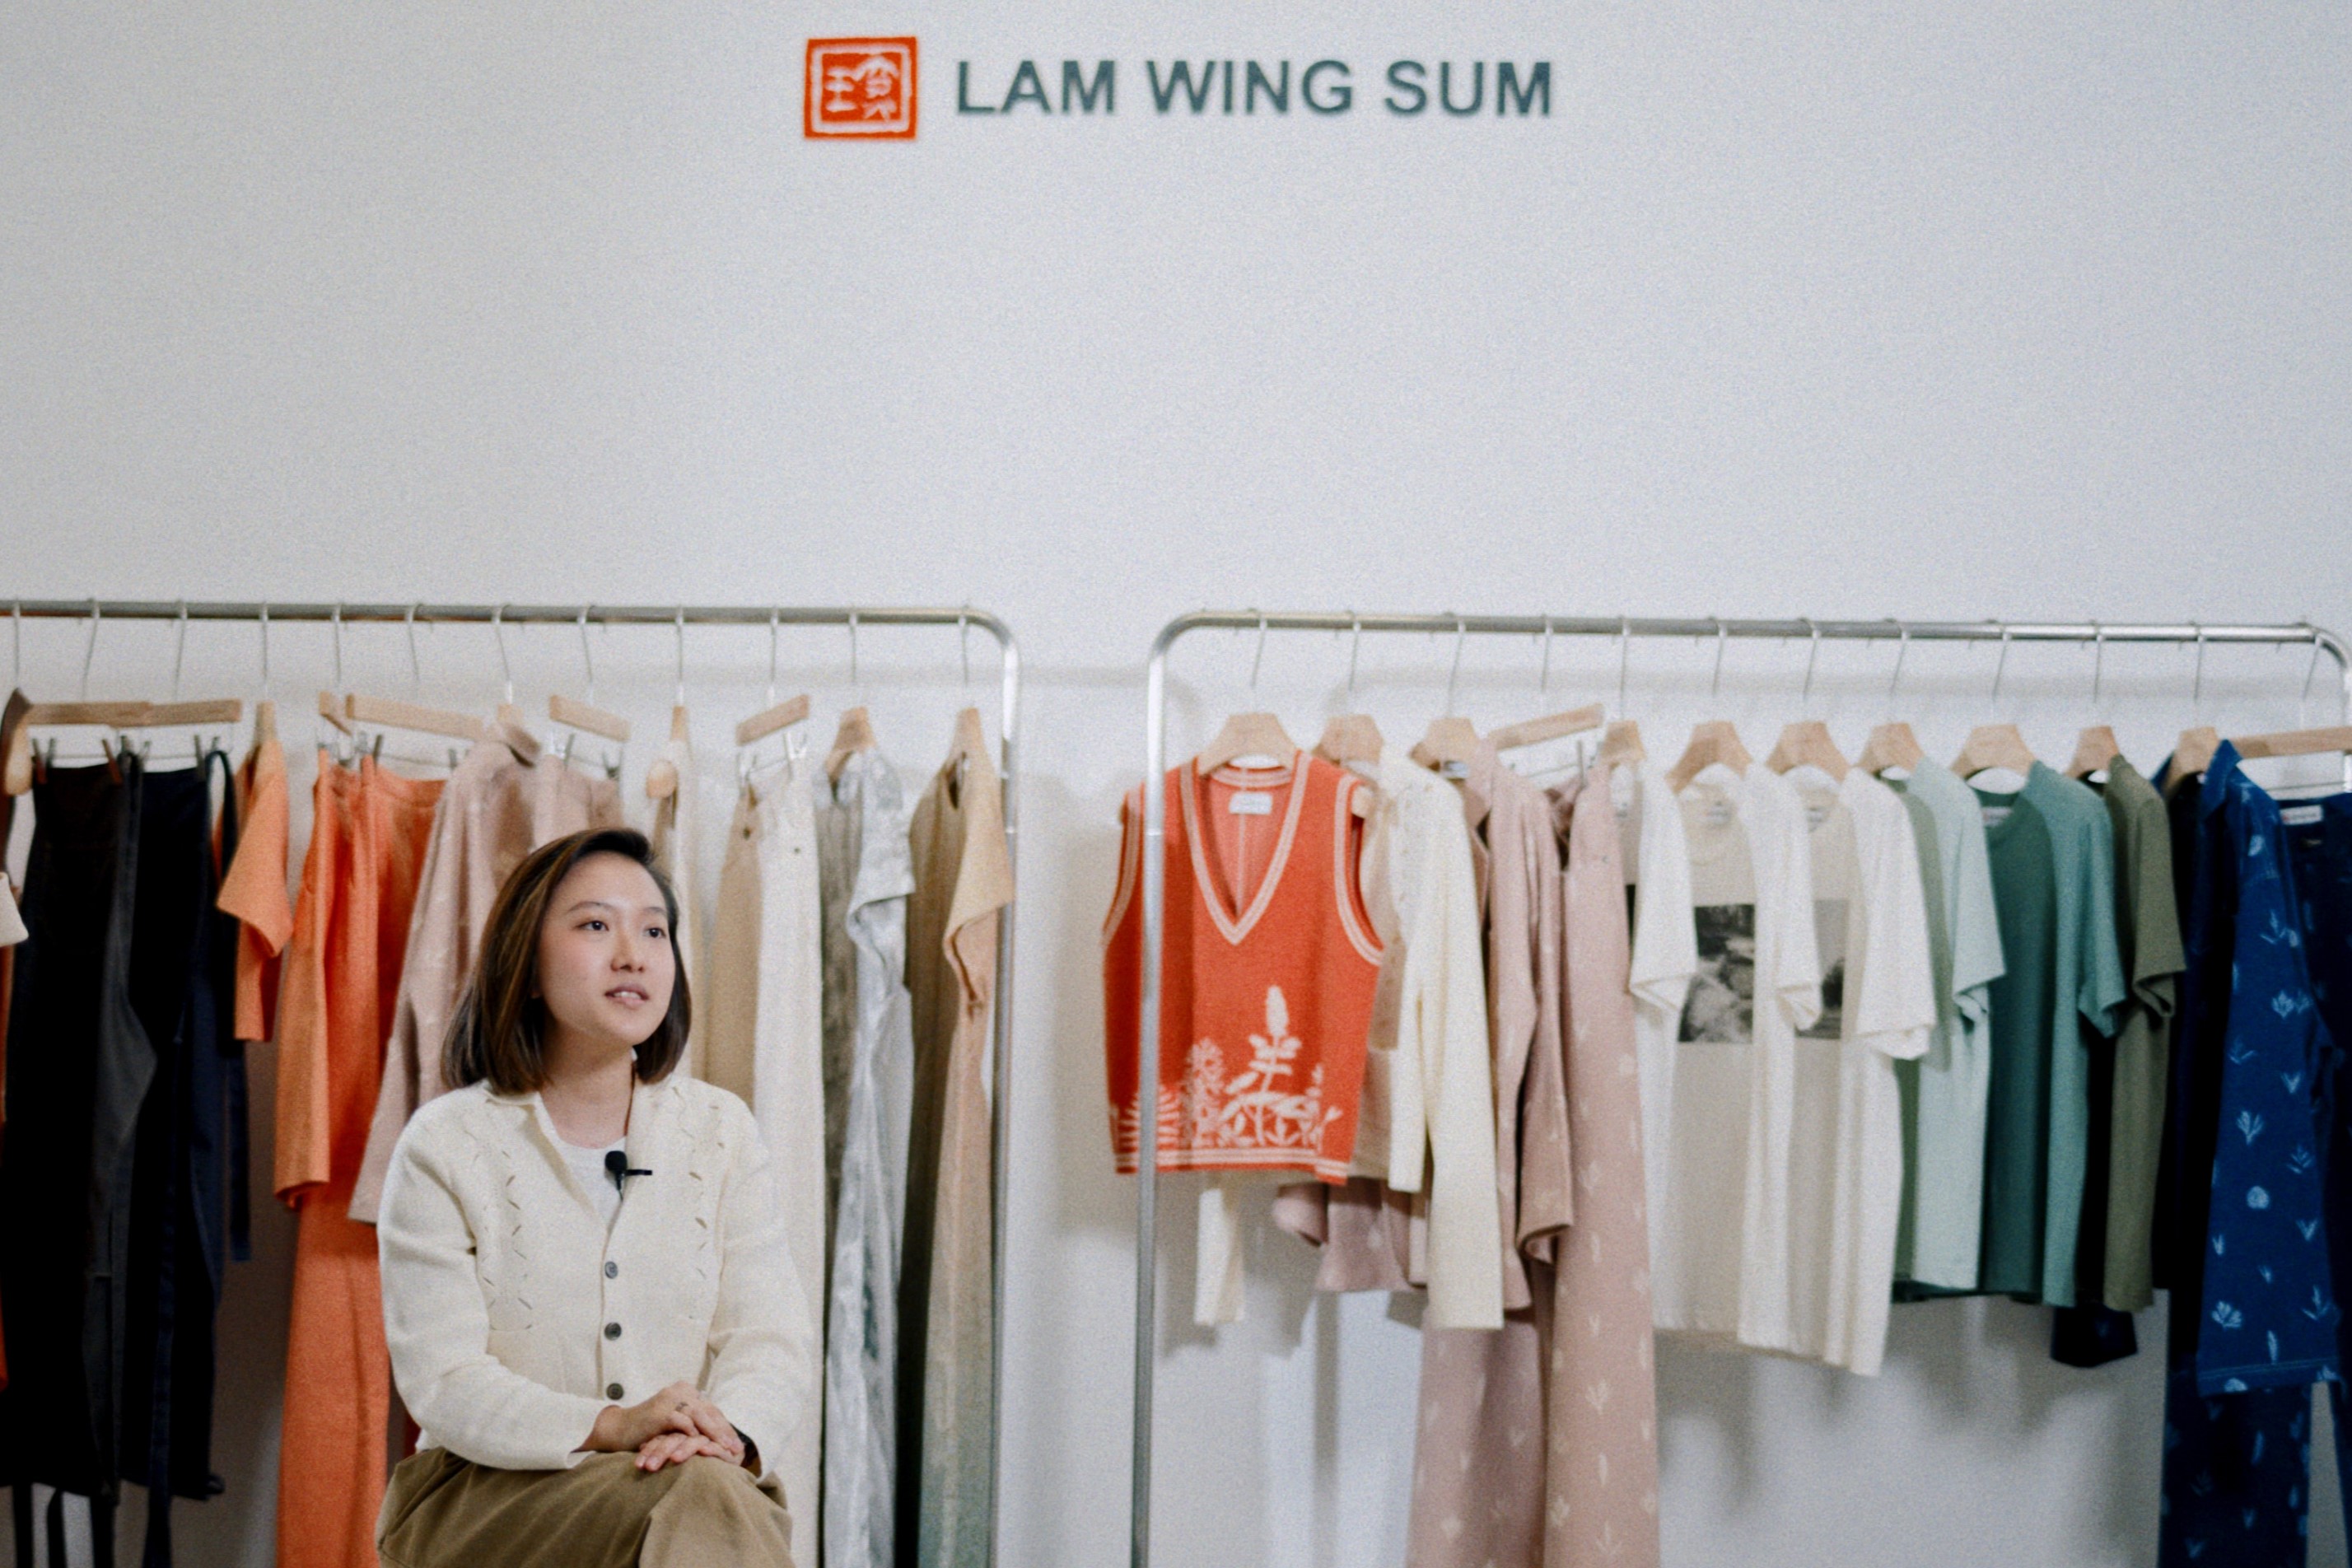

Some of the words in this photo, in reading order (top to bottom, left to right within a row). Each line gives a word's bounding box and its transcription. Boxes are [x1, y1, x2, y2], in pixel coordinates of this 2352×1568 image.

[956, 58, 1116, 115] LAM
[1145, 58, 1353, 117] WING
[1383, 58, 1552, 118] SUM
